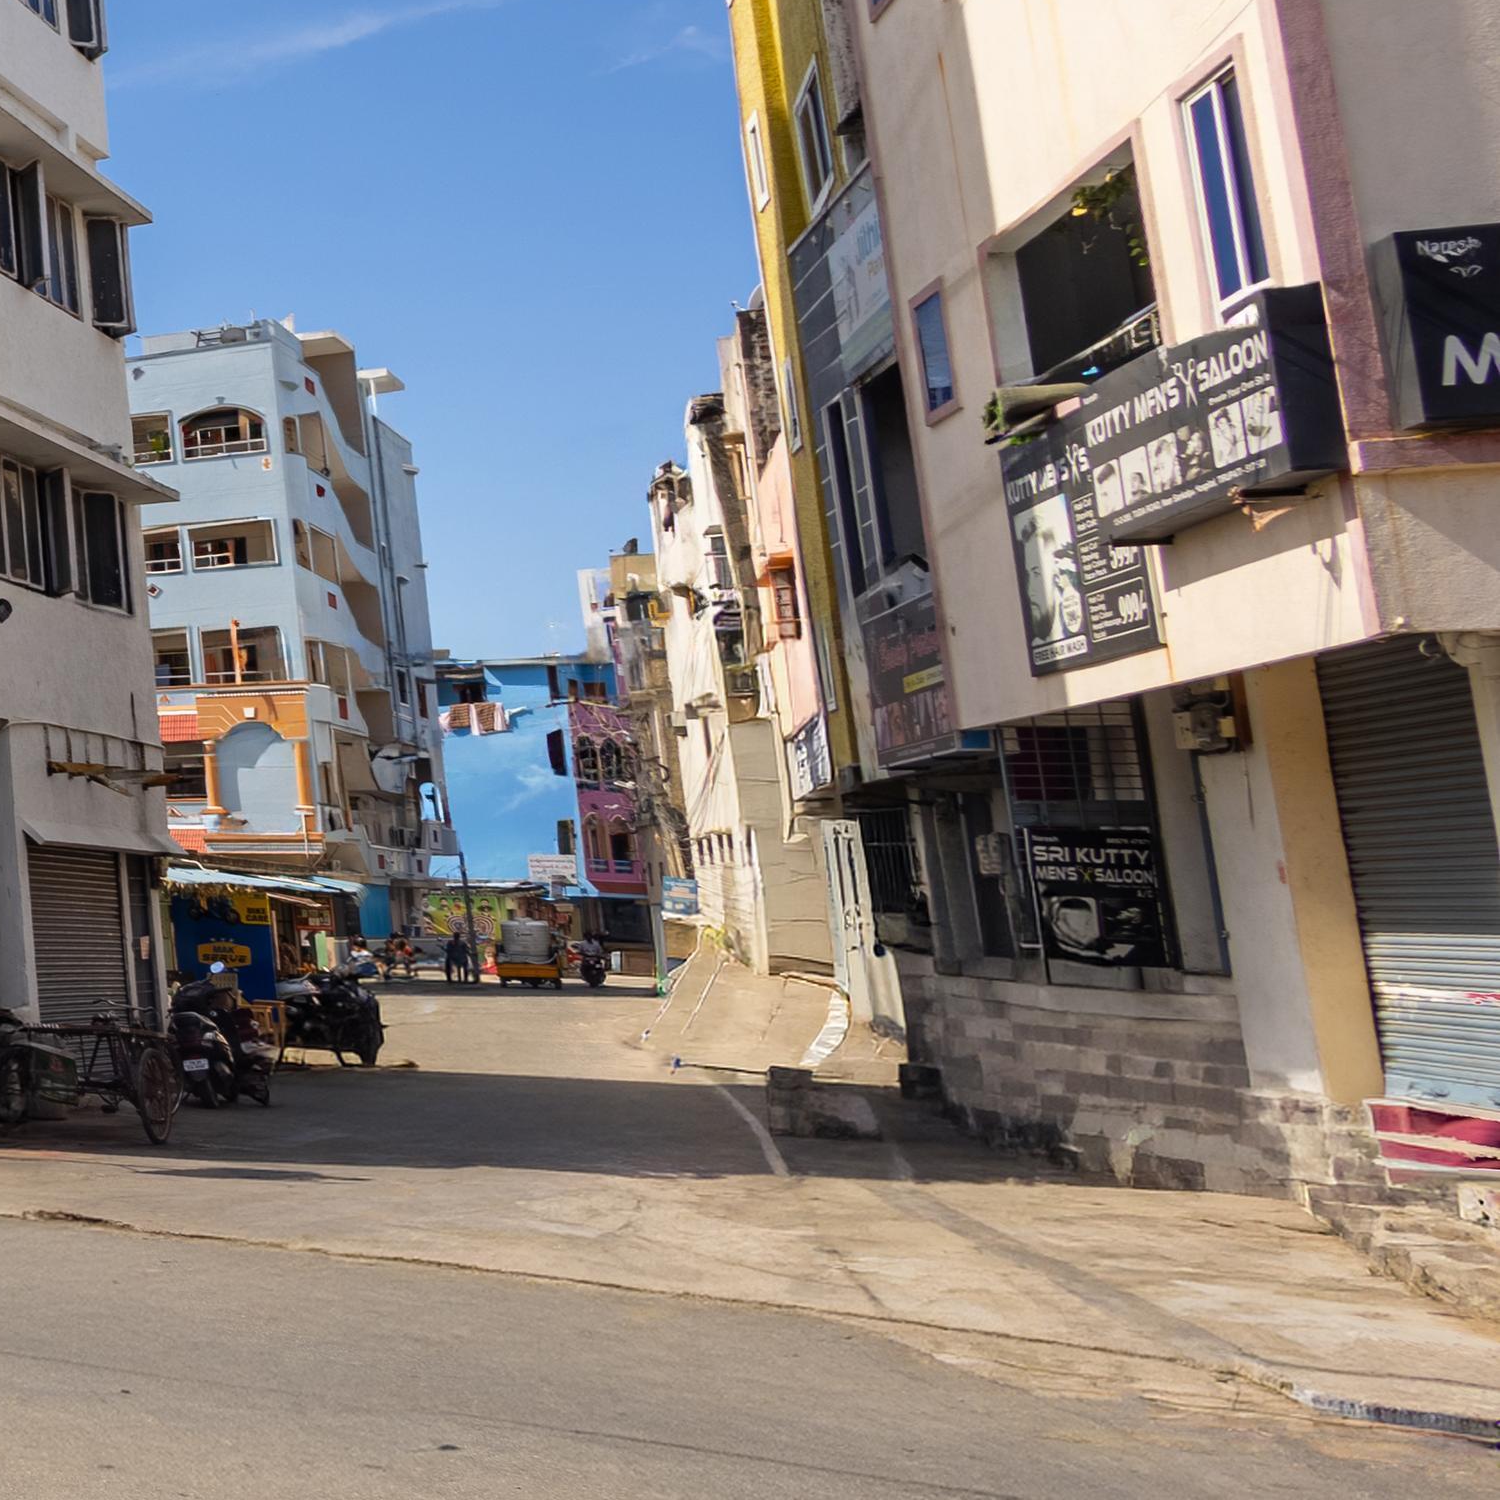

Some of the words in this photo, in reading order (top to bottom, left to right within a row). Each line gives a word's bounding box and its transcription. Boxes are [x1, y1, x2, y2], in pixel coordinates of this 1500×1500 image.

[1085, 401, 1131, 447] KUTTY
[1197, 330, 1270, 392] SALOON
[1118, 589, 1148, 624] 999/-
[1034, 845, 1070, 862] SRI
[1075, 847, 1150, 865] KUTTY
[1035, 865, 1078, 881] MEN'S
[1095, 870, 1154, 884] SALOON
